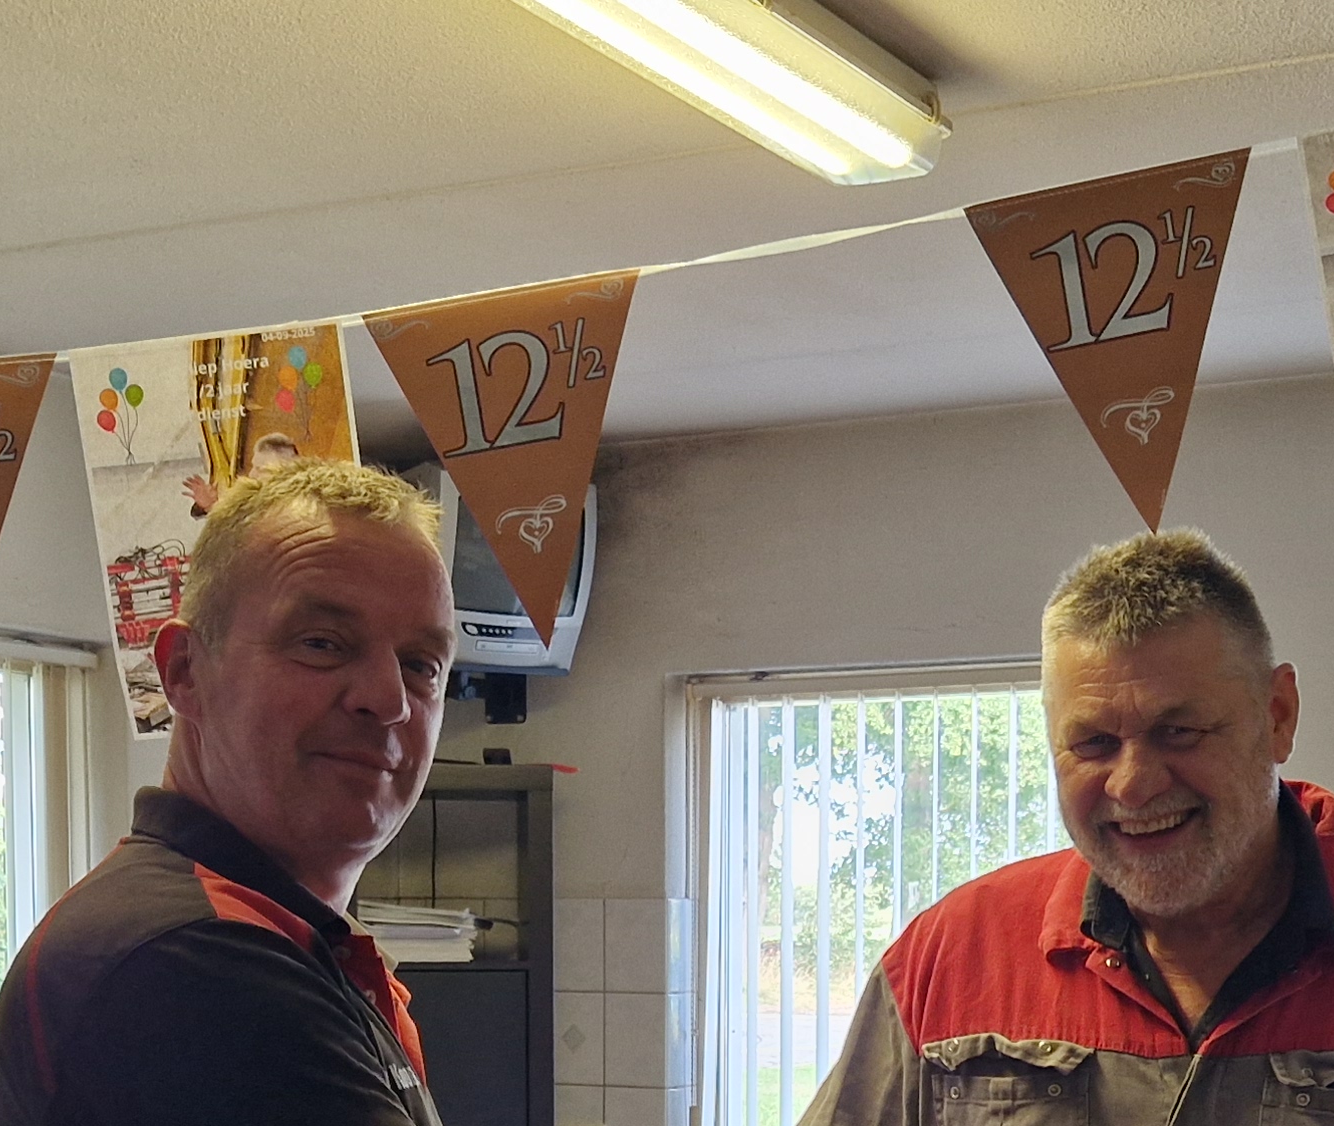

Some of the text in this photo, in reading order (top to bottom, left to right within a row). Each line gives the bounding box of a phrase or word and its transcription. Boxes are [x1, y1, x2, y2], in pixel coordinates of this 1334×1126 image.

[1030, 220, 1174, 352] 12
[261, 328, 316, 343] 04-09-2025
[221, 355, 269, 371] Hoera
[426, 330, 564, 458] 12
[197, 405, 246, 422] dienst
